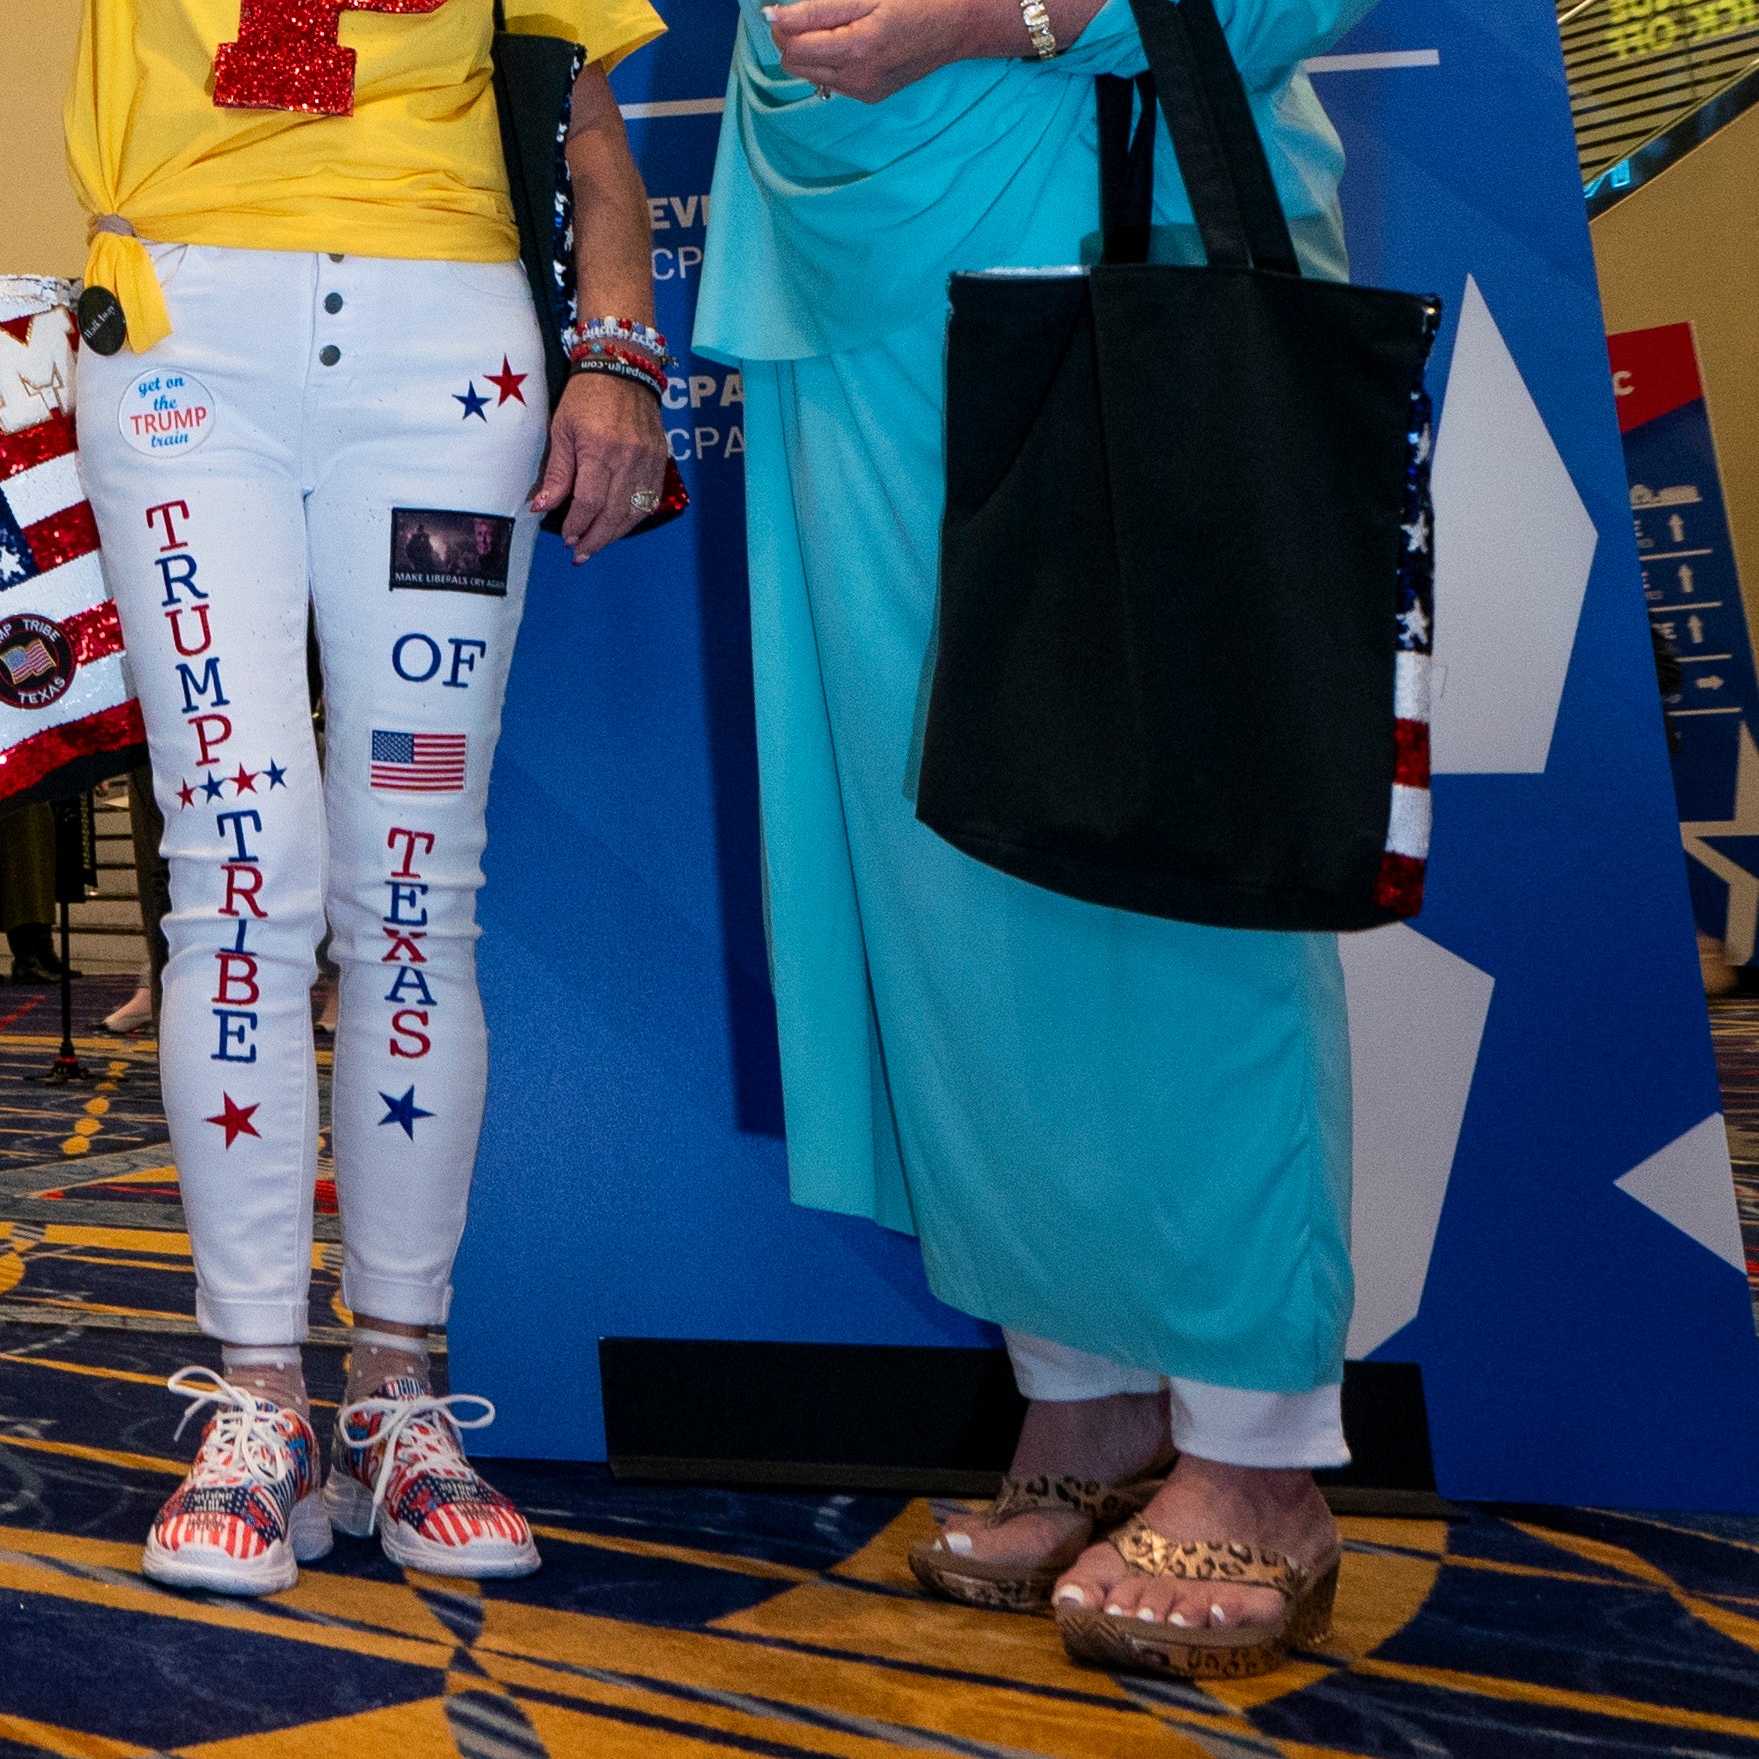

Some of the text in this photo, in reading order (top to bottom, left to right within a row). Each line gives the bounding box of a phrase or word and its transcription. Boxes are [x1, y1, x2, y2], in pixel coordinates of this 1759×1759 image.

[138, 376, 185, 397] get on
[661, 374, 745, 409] CPA
[153, 395, 178, 411] the
[130, 406, 207, 435] TRUMP
[151, 431, 189, 448] train
[395, 572, 423, 583] MAKE
[22, 618, 61, 642] TRIBE
[17, 677, 65, 704] TEXAS
[146, 499, 268, 1065] TRUMP TRIBE
[384, 633, 486, 1059] OF TEXAS
